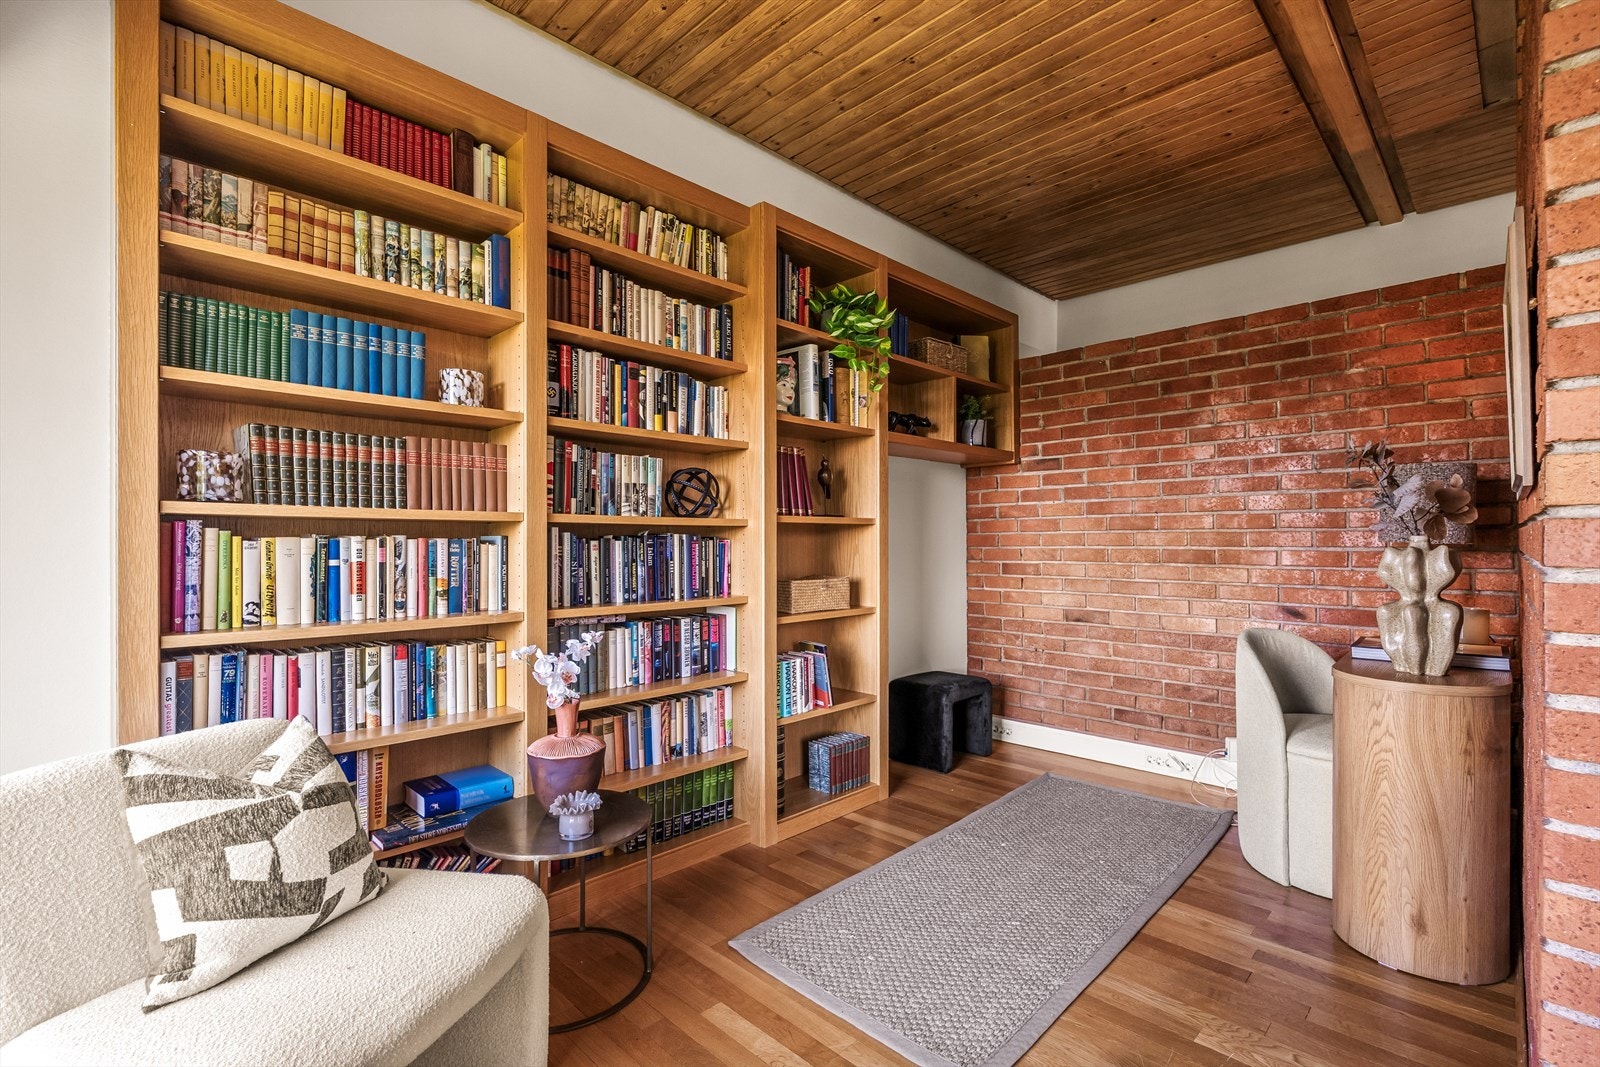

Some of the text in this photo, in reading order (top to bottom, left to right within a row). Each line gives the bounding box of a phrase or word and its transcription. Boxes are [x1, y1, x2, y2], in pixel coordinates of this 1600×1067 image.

[450, 556, 459, 587] RØTTER
[375, 762, 383, 819] KRYSSORDLØSER
[409, 835, 420, 843] DET
[420, 830, 436, 841] STORE
